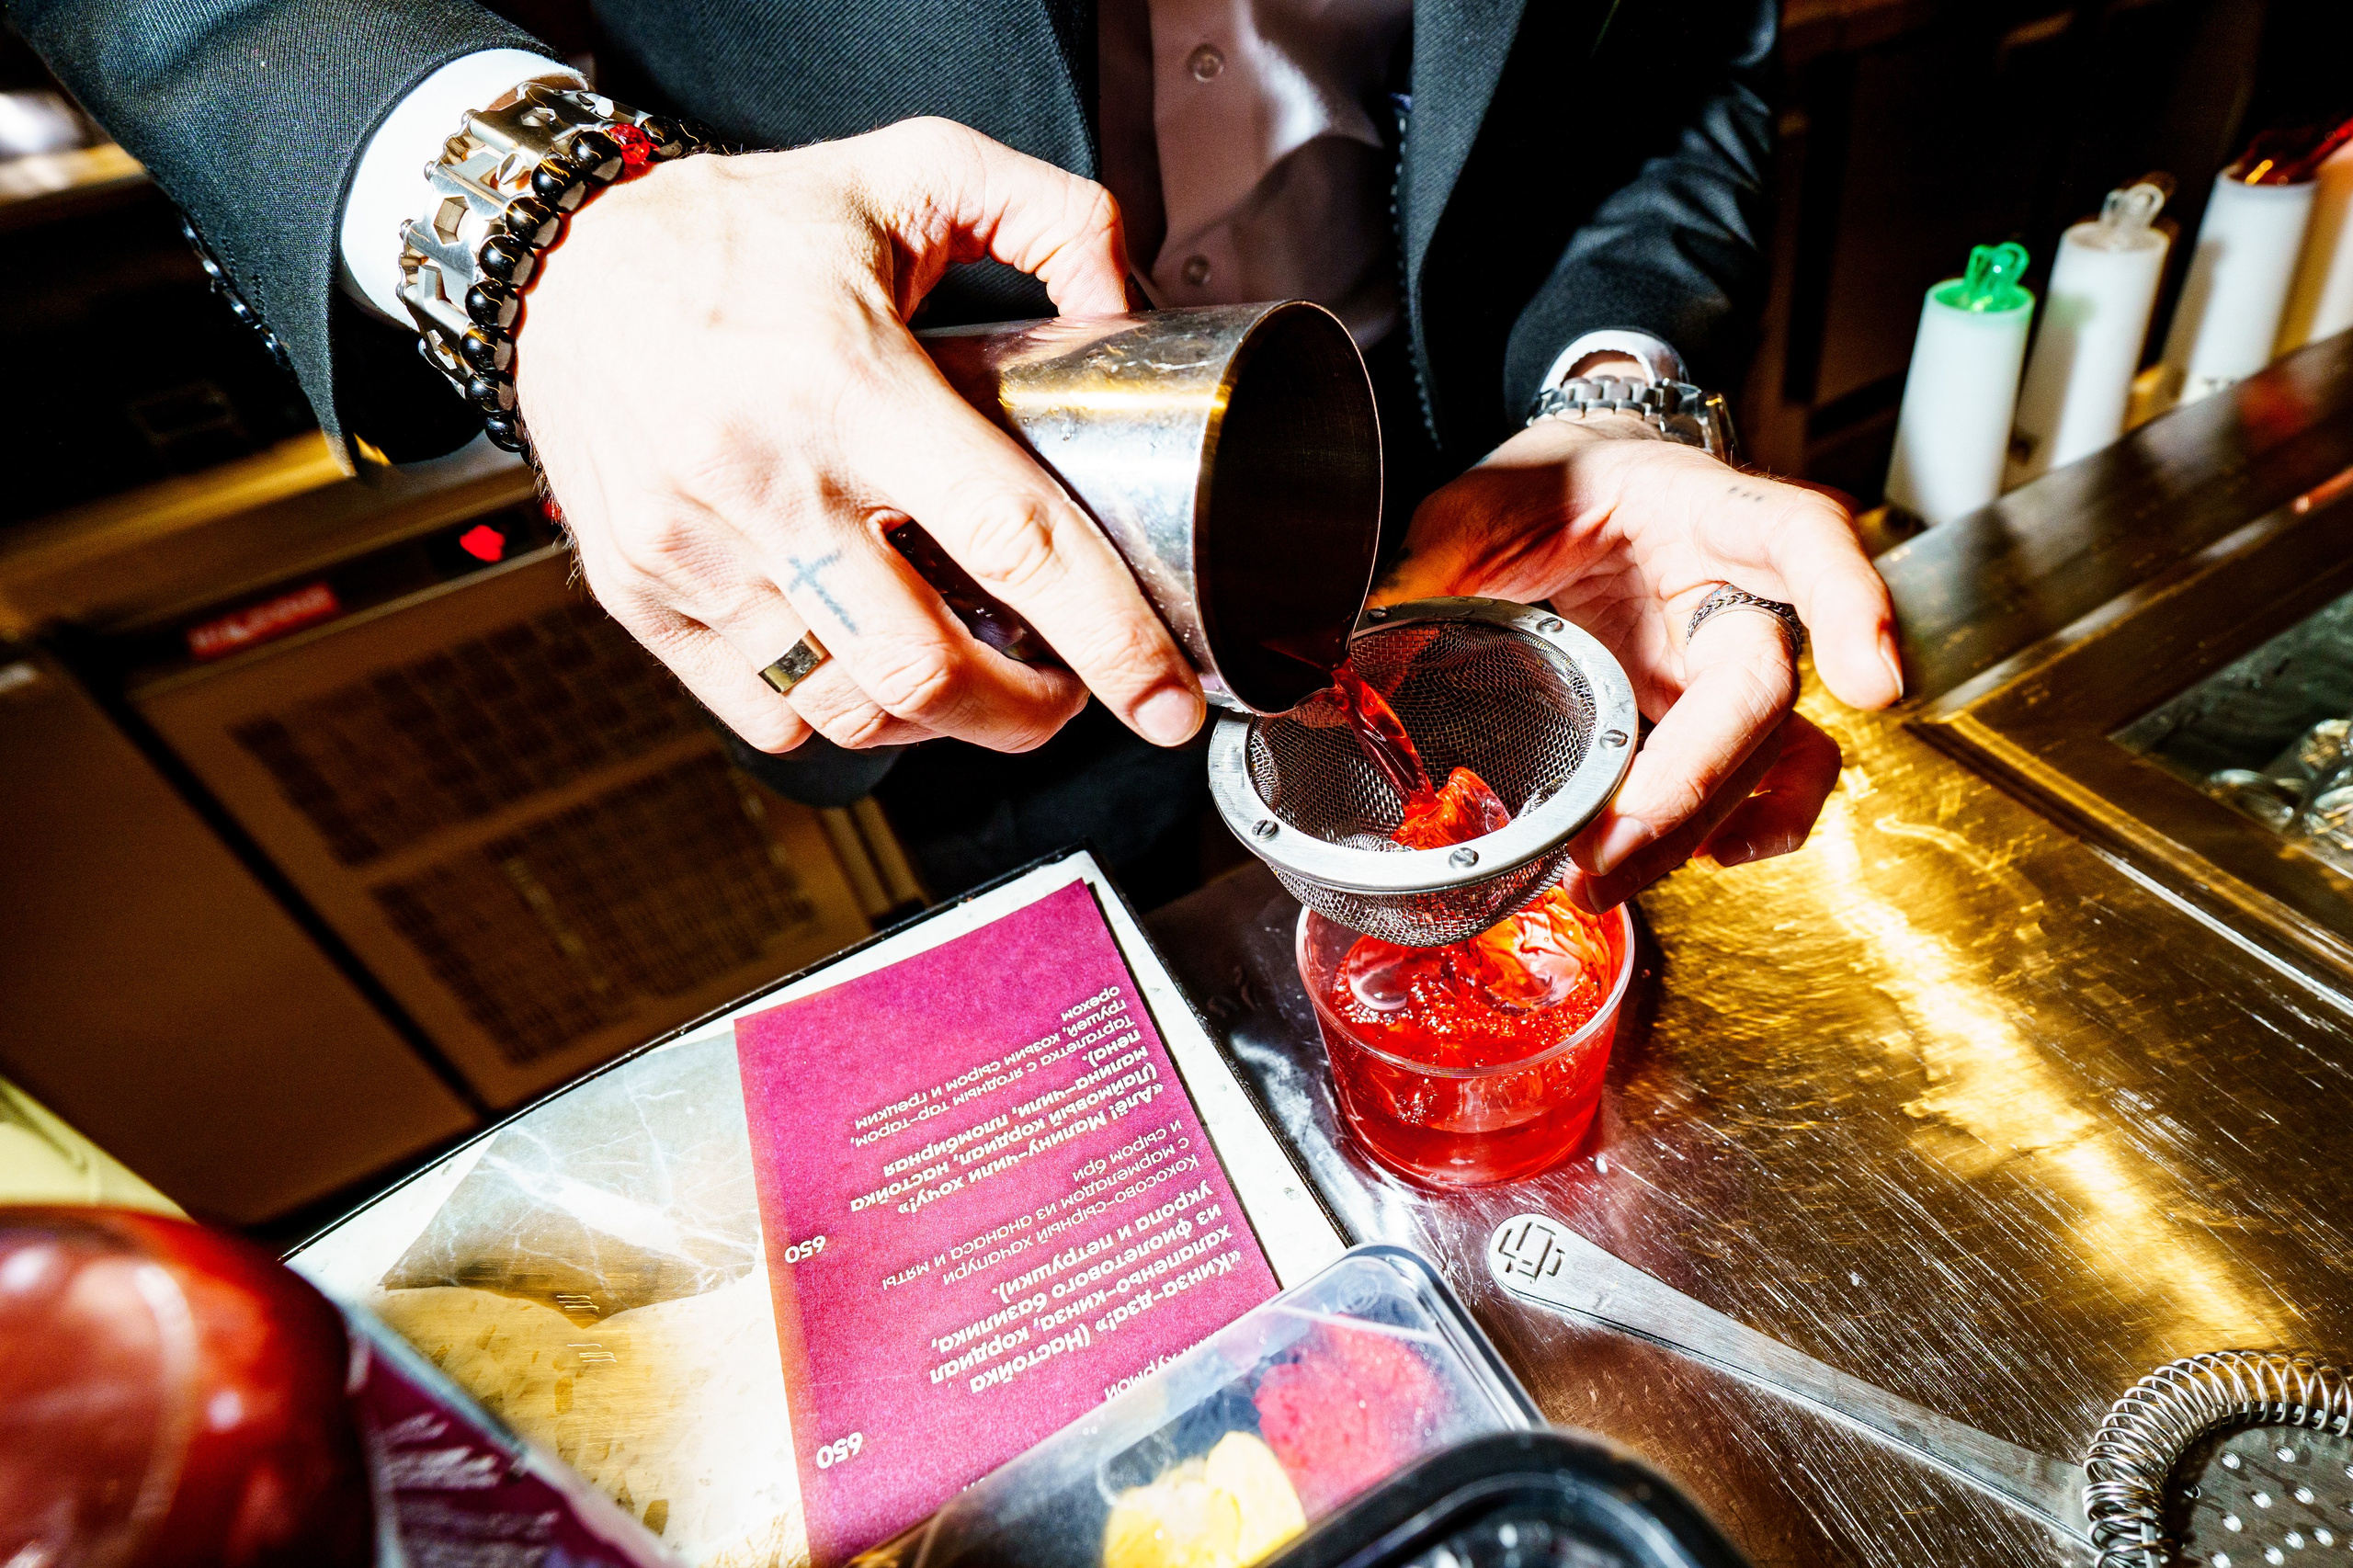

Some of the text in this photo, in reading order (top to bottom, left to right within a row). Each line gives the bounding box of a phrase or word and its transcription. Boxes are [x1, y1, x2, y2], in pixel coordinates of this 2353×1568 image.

[855, 999, 1127, 1131] грушей, козьим сыром и грецким
[1061, 986, 1120, 1022] орехом
[1081, 1028, 1142, 1068] пена).
[849, 1062, 1157, 1212] (Лаймовый кордиал, настойка
[850, 1015, 1135, 1148] Тарталетка с ягодным тар-таром,
[882, 1113, 1009, 1177] пломбирная
[897, 1083, 1164, 1214] «Алё! Малину-чили хочу!»
[1072, 1119, 1183, 1182] и сыром бри
[784, 1235, 826, 1264] 650
[881, 1137, 1189, 1290] с мармеладом из ананаса и мяты
[942, 1153, 1199, 1286] Кокосово-сырный хачапури
[991, 1179, 1214, 1304] укропа и петрушки).
[931, 1203, 1222, 1354] из фиолетового базилика,
[969, 1249, 1242, 1394] «Кинза-дза!» (Настойка
[1032, 1223, 1233, 1333] халапеньо-кинза,
[815, 1431, 864, 1470] 650
